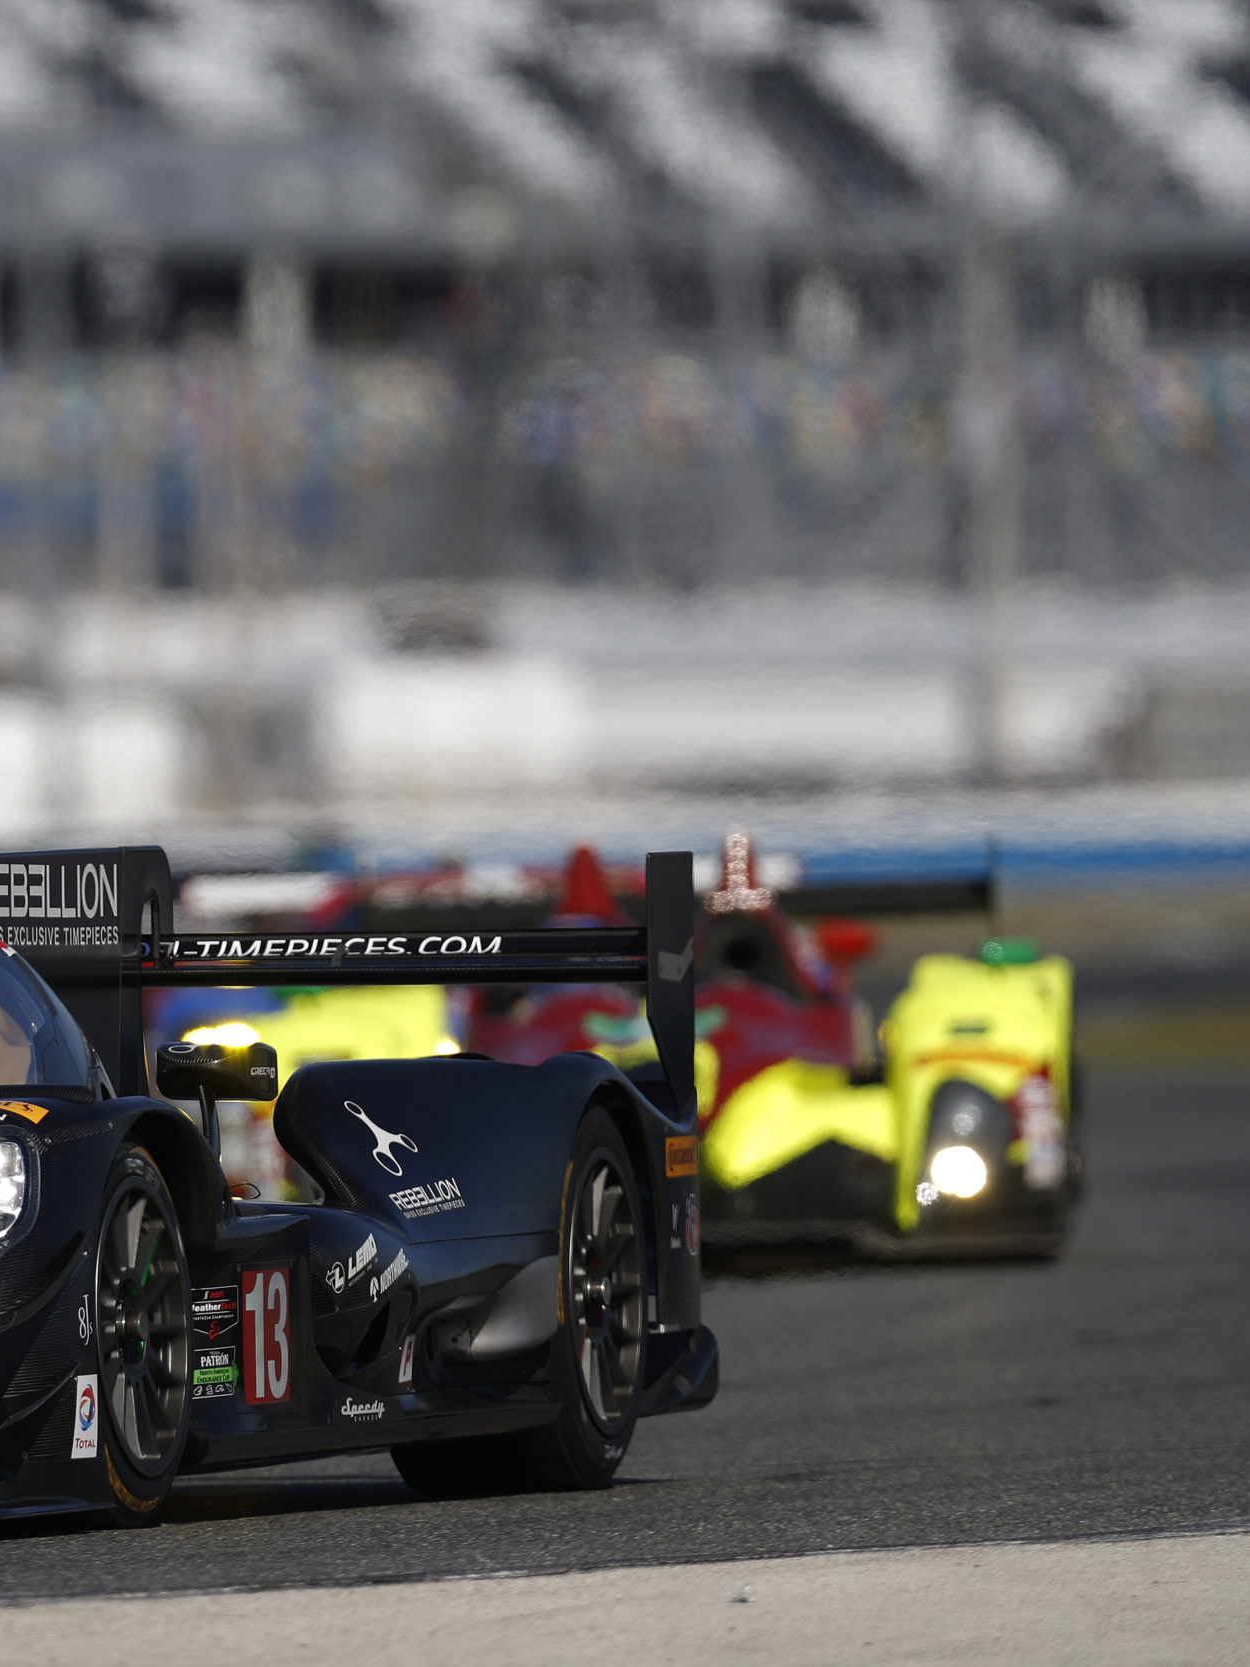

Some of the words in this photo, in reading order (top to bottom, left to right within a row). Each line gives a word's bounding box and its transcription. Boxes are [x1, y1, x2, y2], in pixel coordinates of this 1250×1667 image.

[7, 926, 60, 946] EXCLUSIVE
[63, 925, 119, 946] TIMEPIECES
[388, 1177, 462, 1212] REBELLION
[416, 1204, 440, 1217] EXCLUSIVE
[439, 1198, 466, 1211] TIMEPIECES
[347, 1232, 378, 1280] LEMO
[245, 1271, 289, 1399] 13
